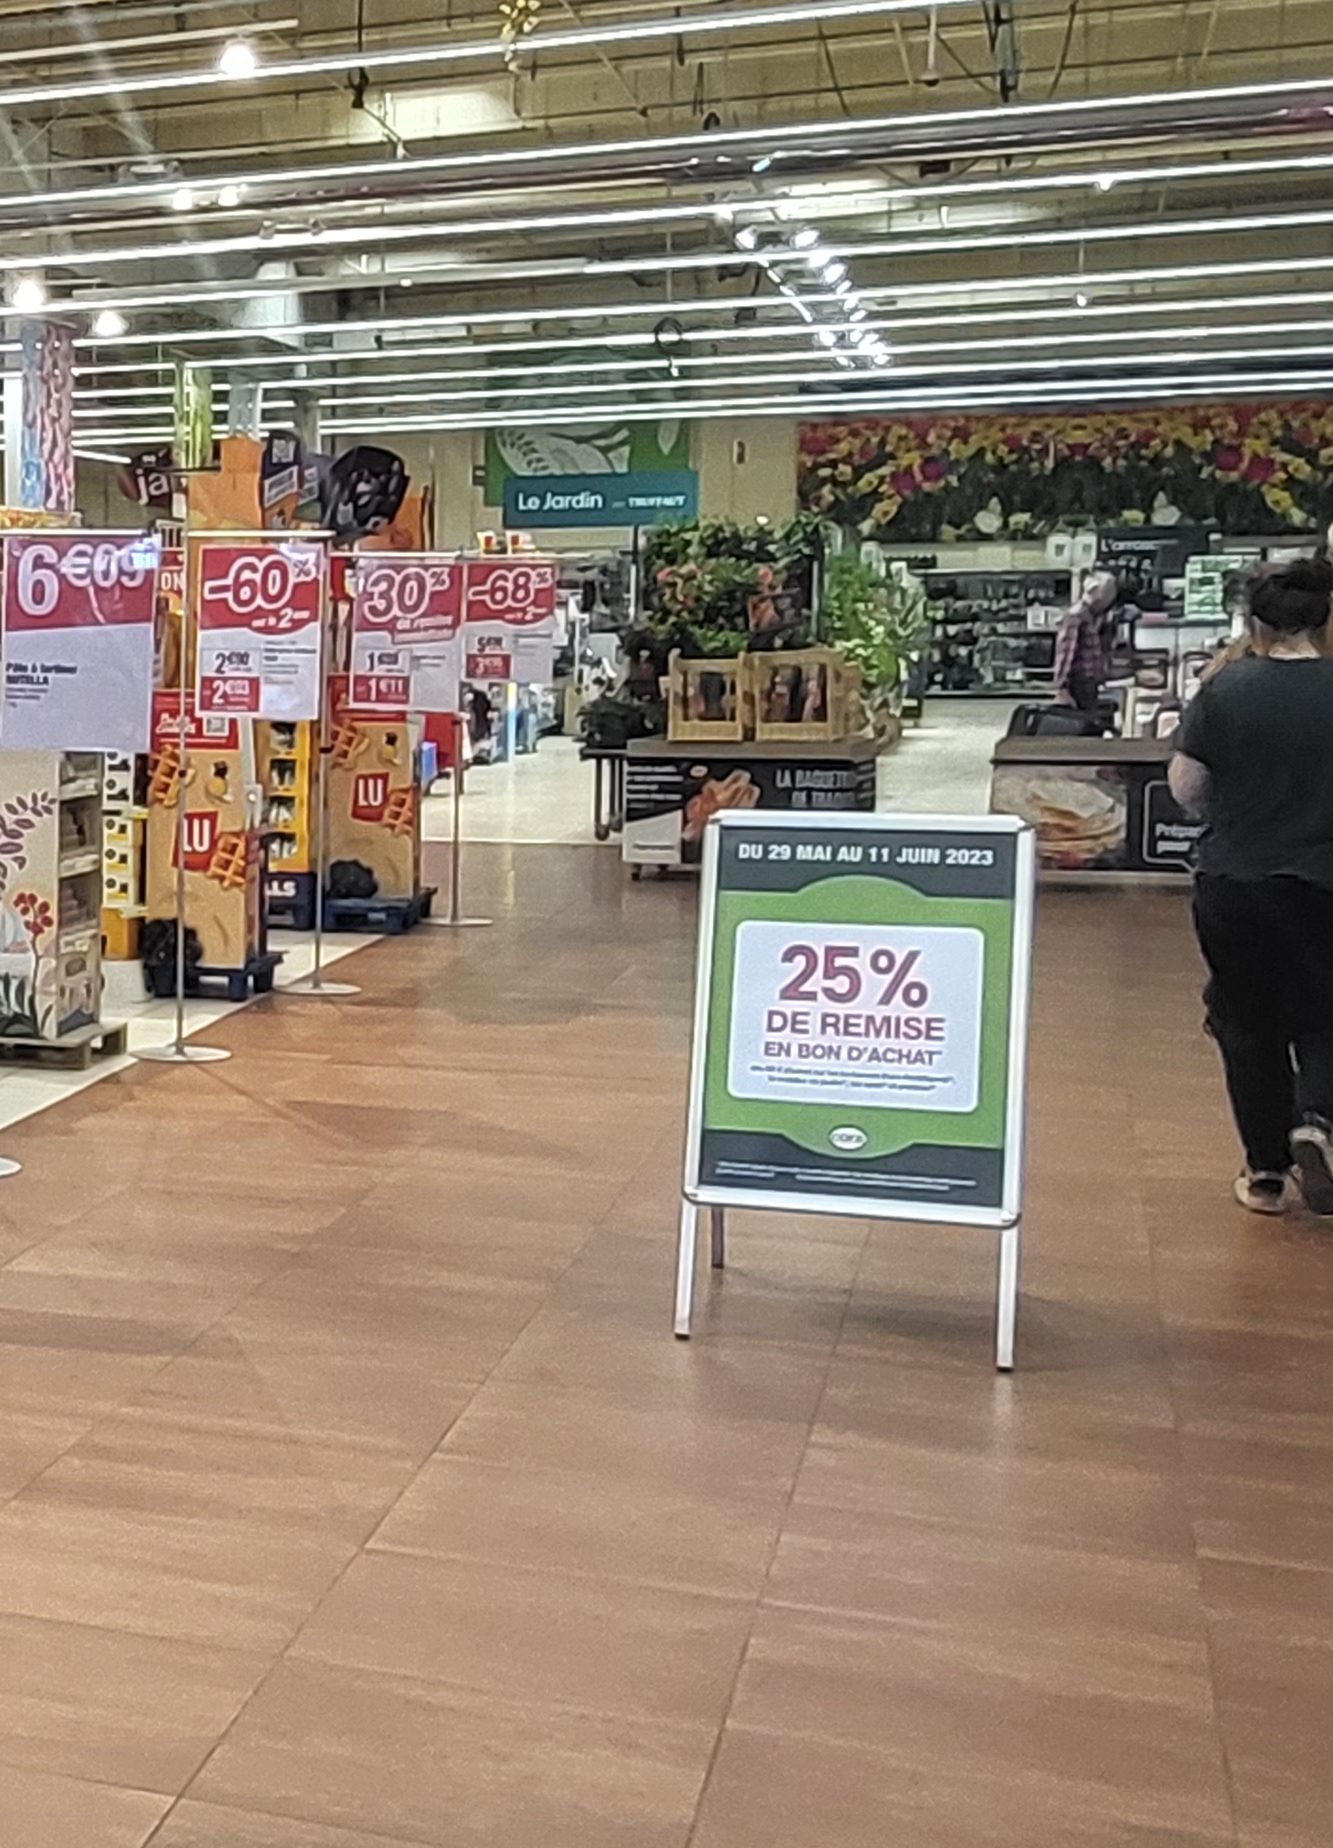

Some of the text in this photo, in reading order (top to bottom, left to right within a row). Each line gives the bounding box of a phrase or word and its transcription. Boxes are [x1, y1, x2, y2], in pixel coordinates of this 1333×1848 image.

[518, 492, 541, 511] Le
[542, 491, 604, 511] Jardin
[17, 543, 146, 616] 6€09
[363, 567, 450, 623] 30%
[358, 778, 383, 806] LU
[738, 843, 994, 866] DU 29 MAI AU 11 JUIN 2023
[766, 1010, 946, 1042] DE REMISE
[764, 1042, 793, 1059] EN
[797, 1043, 842, 1061] BON
